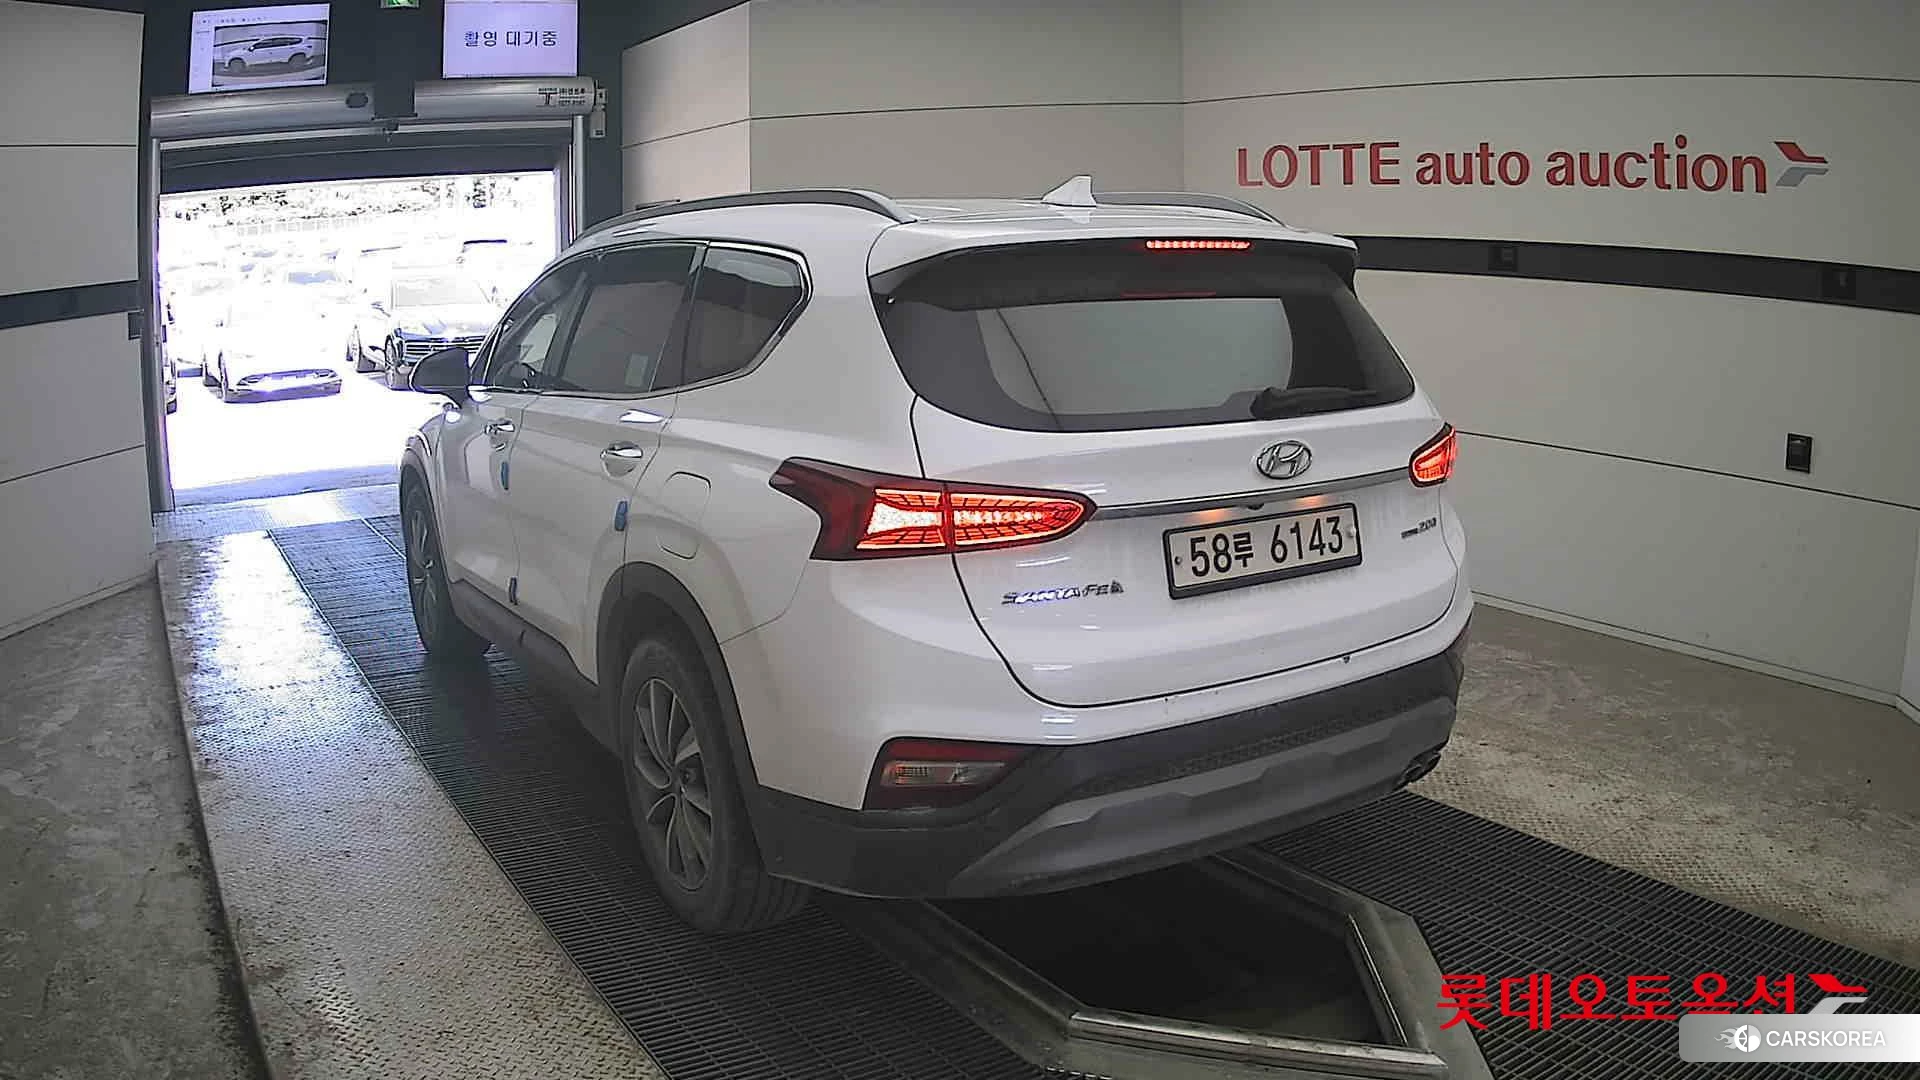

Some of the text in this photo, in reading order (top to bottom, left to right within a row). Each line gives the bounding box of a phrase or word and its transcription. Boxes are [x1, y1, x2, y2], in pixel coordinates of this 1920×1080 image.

[506, 31, 558, 47] 대기중
[1237, 135, 1768, 193] LOTTE auto auction
[1190, 516, 1344, 578] 58루 6143
